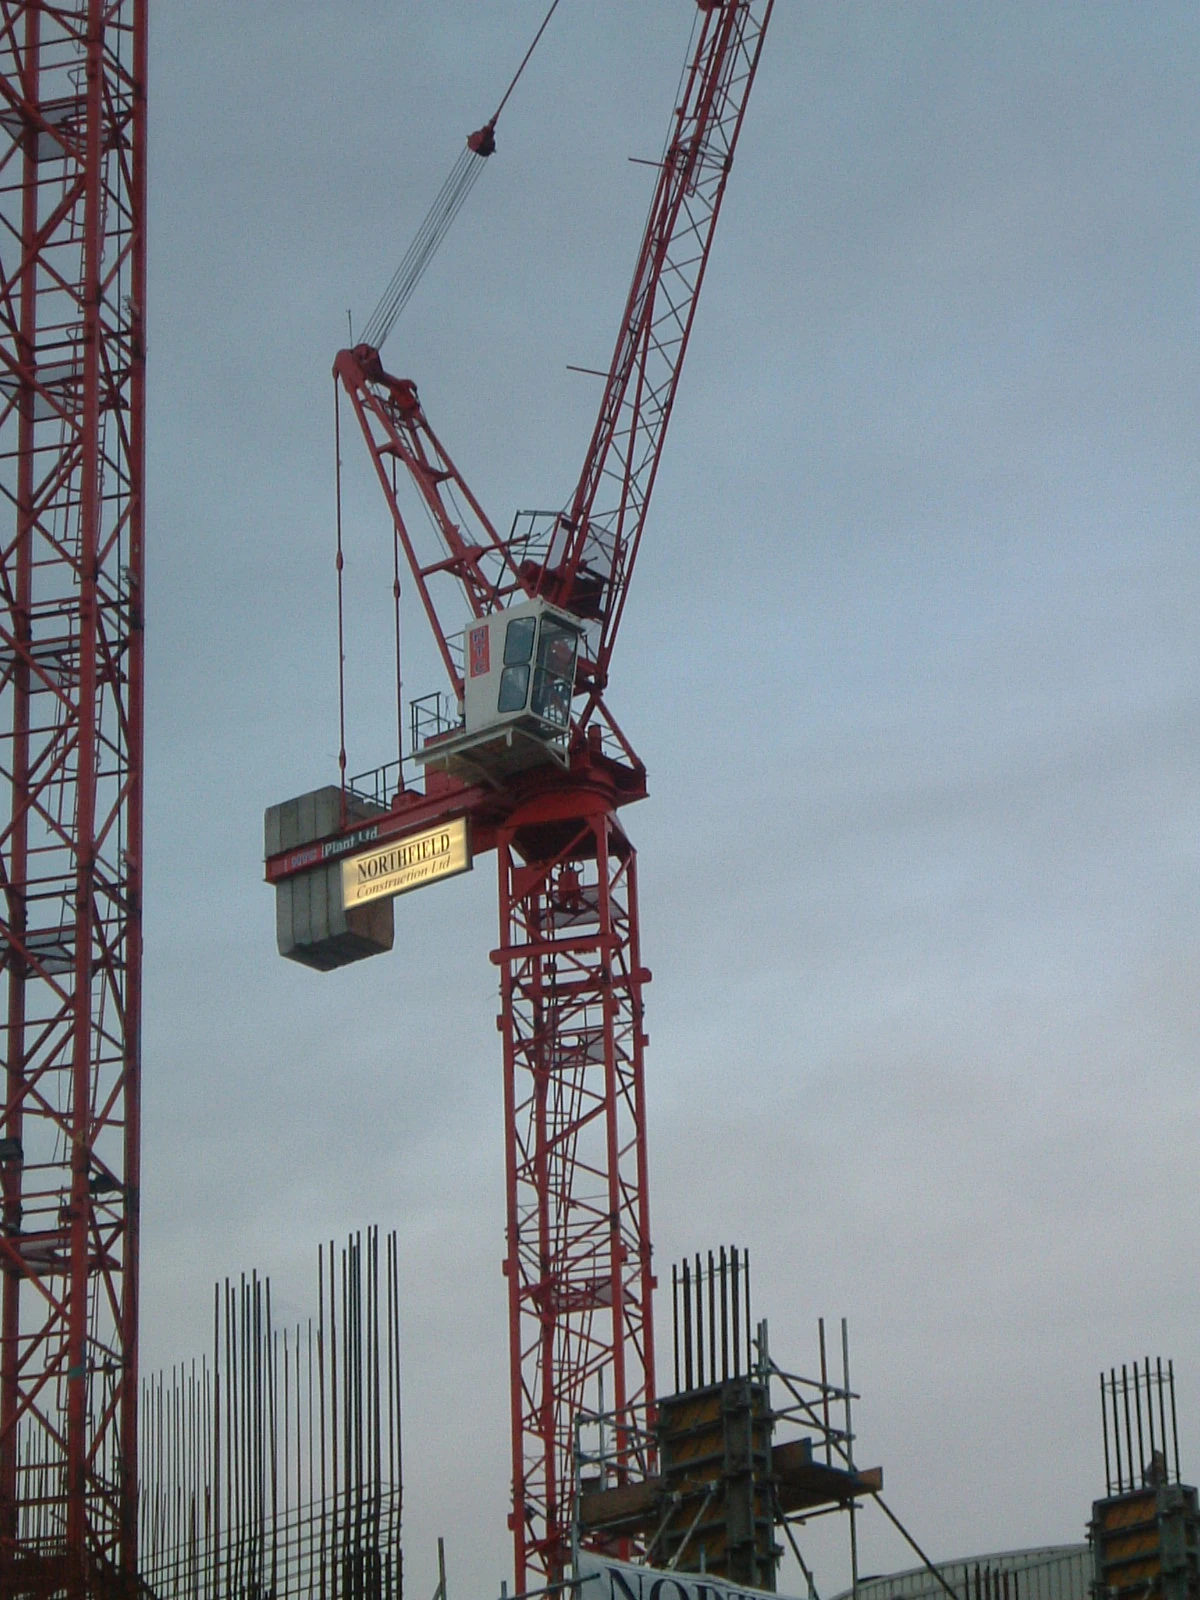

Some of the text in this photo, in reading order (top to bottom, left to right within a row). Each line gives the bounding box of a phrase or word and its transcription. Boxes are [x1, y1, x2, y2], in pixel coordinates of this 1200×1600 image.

[325, 826, 378, 857] Plant Ltd
[358, 834, 450, 881] NORTHFIELD
[357, 855, 451, 899] Construction Ltd
